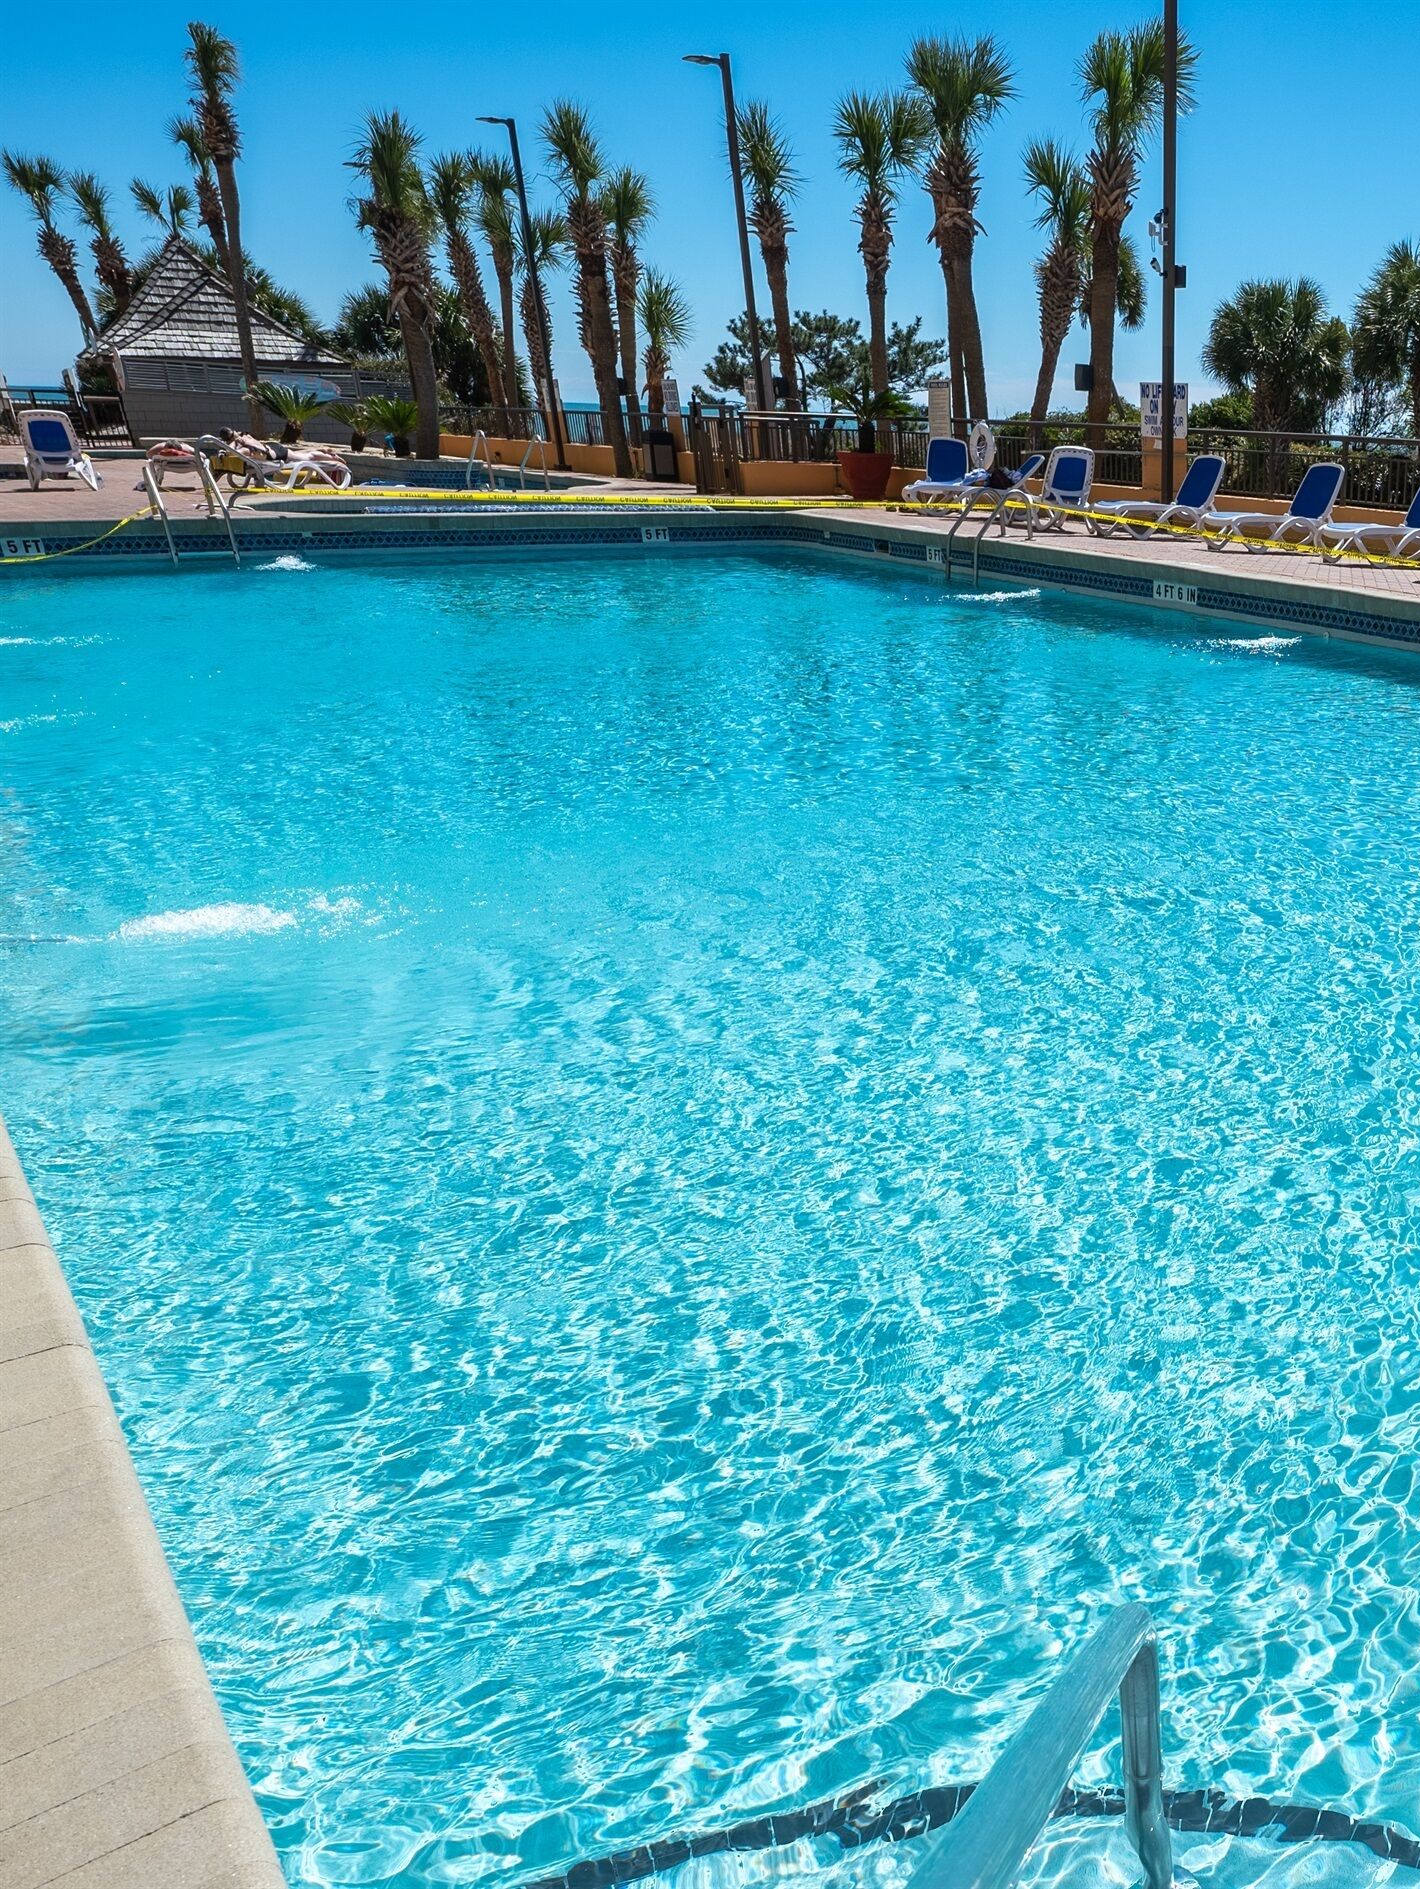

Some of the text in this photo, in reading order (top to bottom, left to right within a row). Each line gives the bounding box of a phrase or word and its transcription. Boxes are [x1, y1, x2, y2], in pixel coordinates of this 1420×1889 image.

[1141, 384, 1186, 400] NO LIFARD
[1150, 400, 1158, 414] ON
[645, 529, 668, 540] 5 FT
[7, 540, 41, 554] 5 FT
[928, 548, 932, 560] 5
[1156, 584, 1196, 602] 4 FT 6 IN
